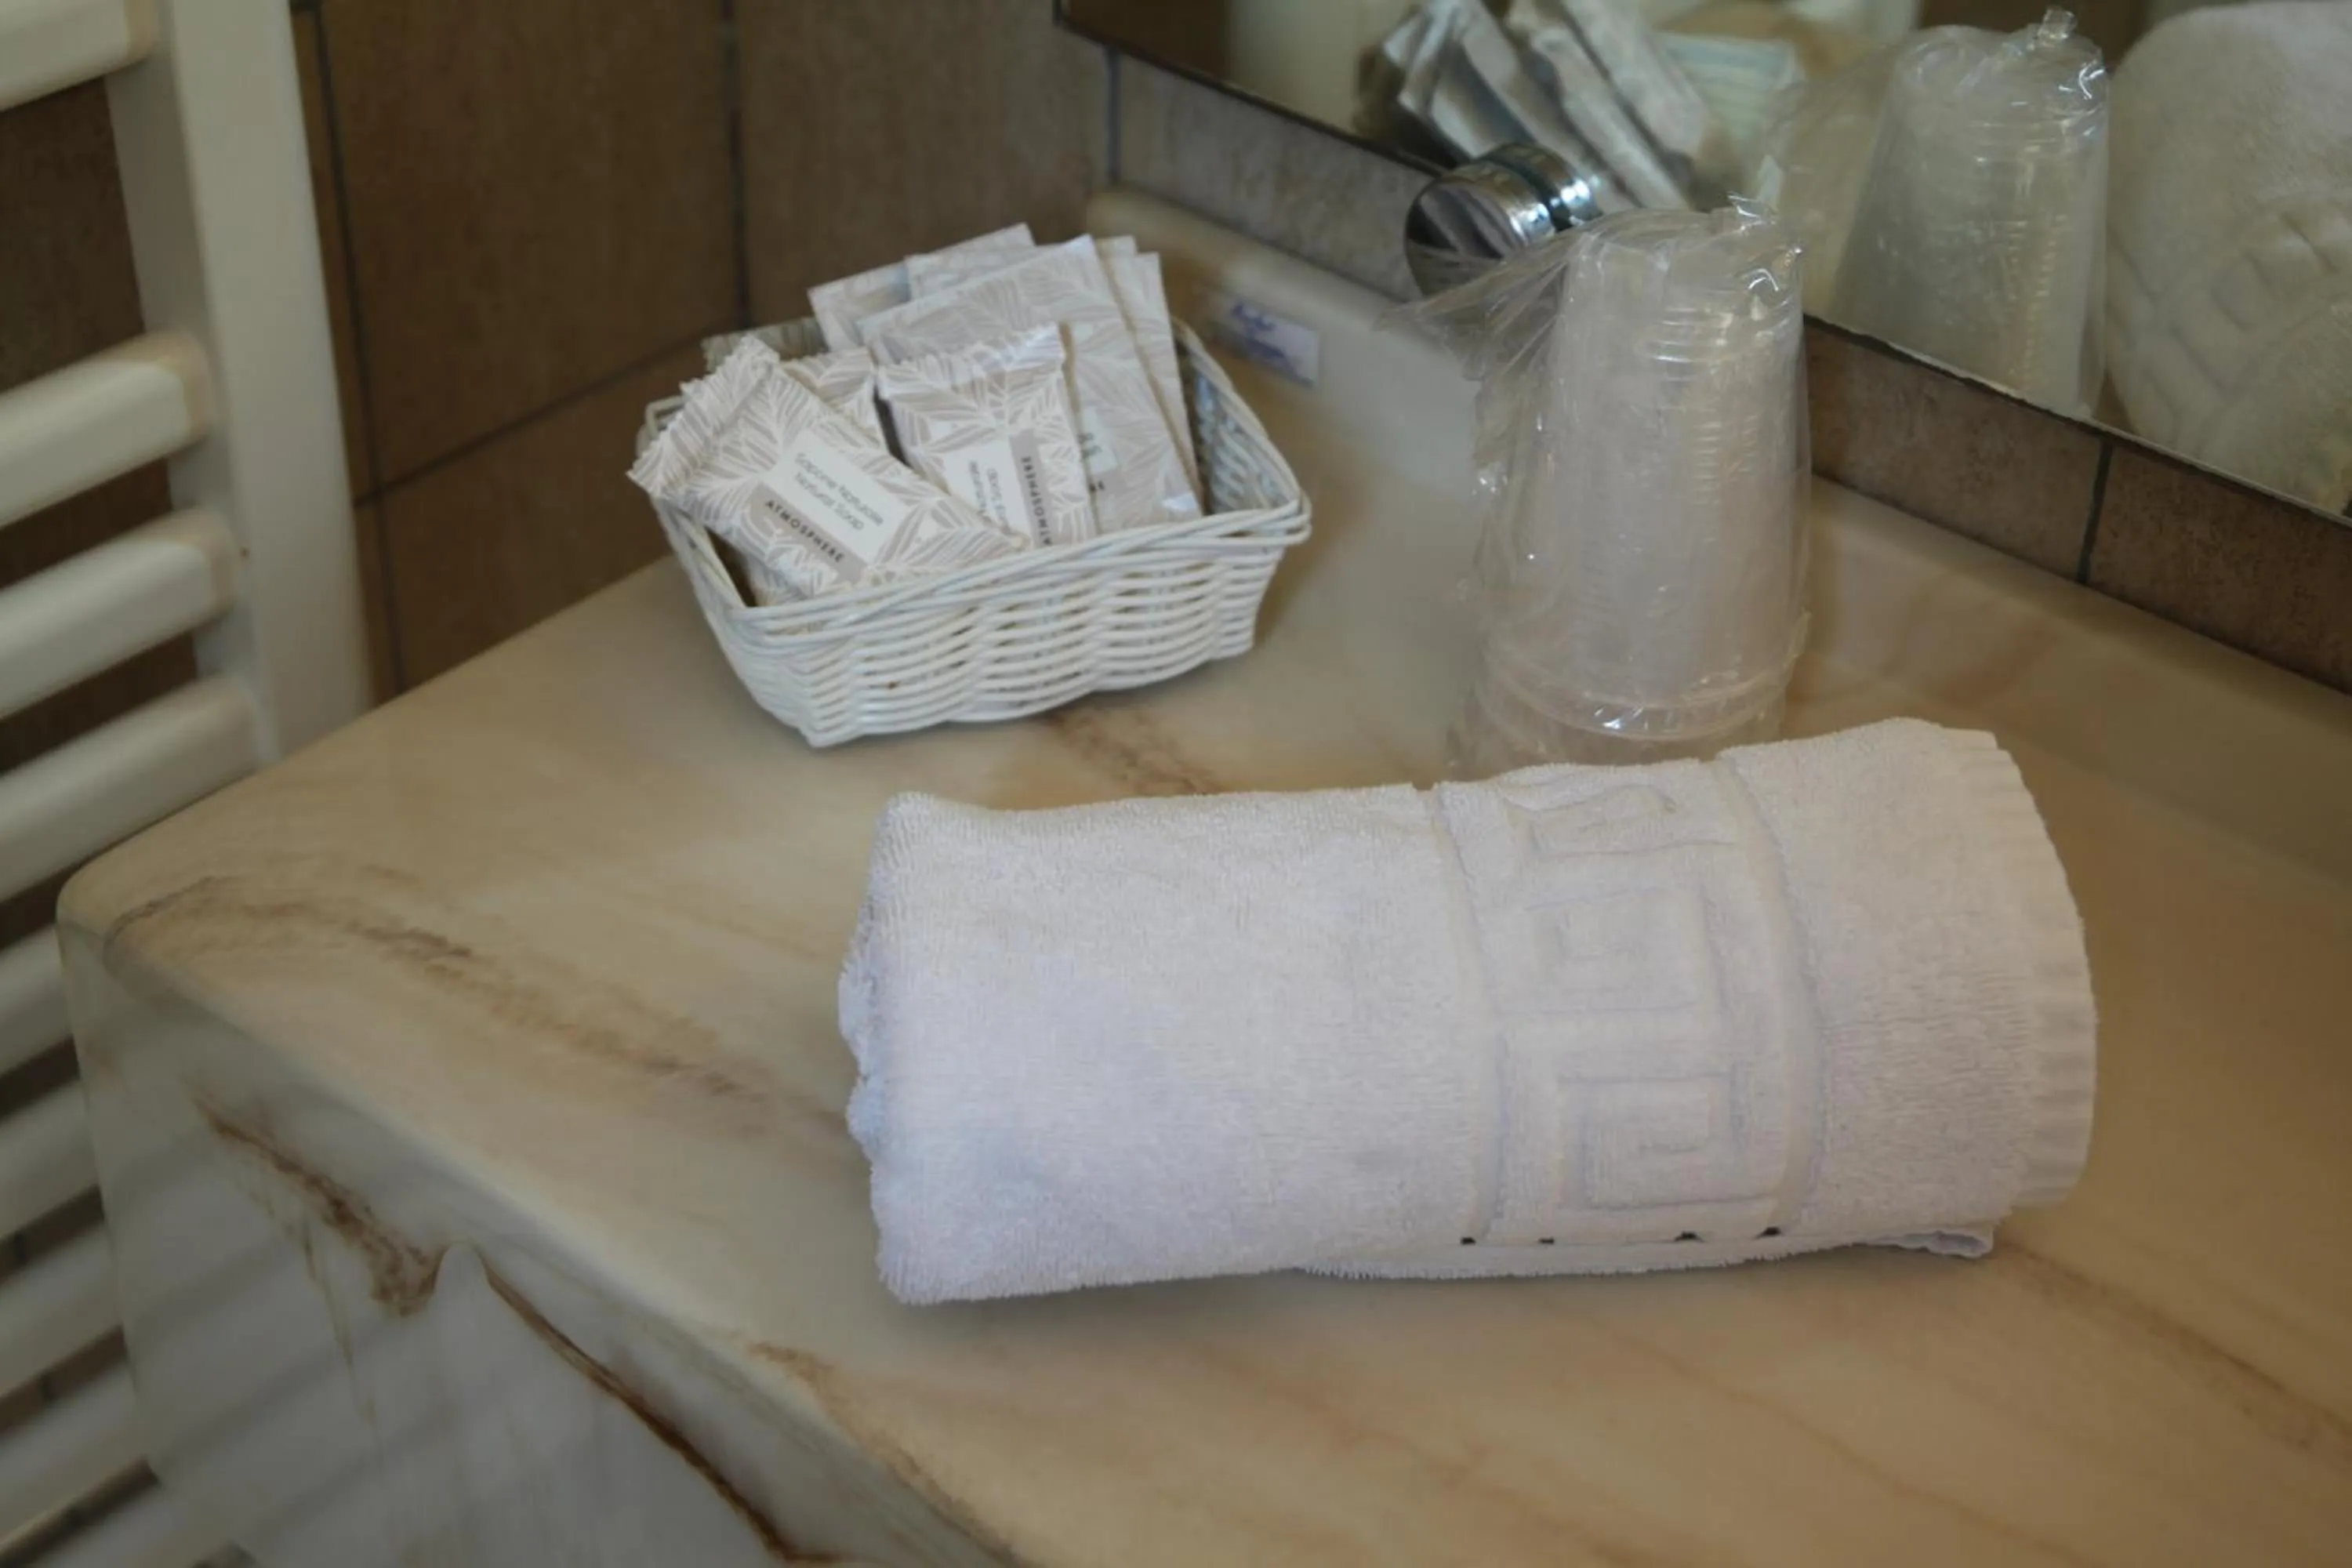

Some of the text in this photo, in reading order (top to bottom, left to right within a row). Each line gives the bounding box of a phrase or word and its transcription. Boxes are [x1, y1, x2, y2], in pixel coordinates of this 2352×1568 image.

[794, 452, 884, 527] Sapone Naturale
[795, 471, 865, 531] Natural Soap
[1021, 455, 1053, 546] ATMOSPHERE
[764, 499, 845, 562] ATMOSPHERE
